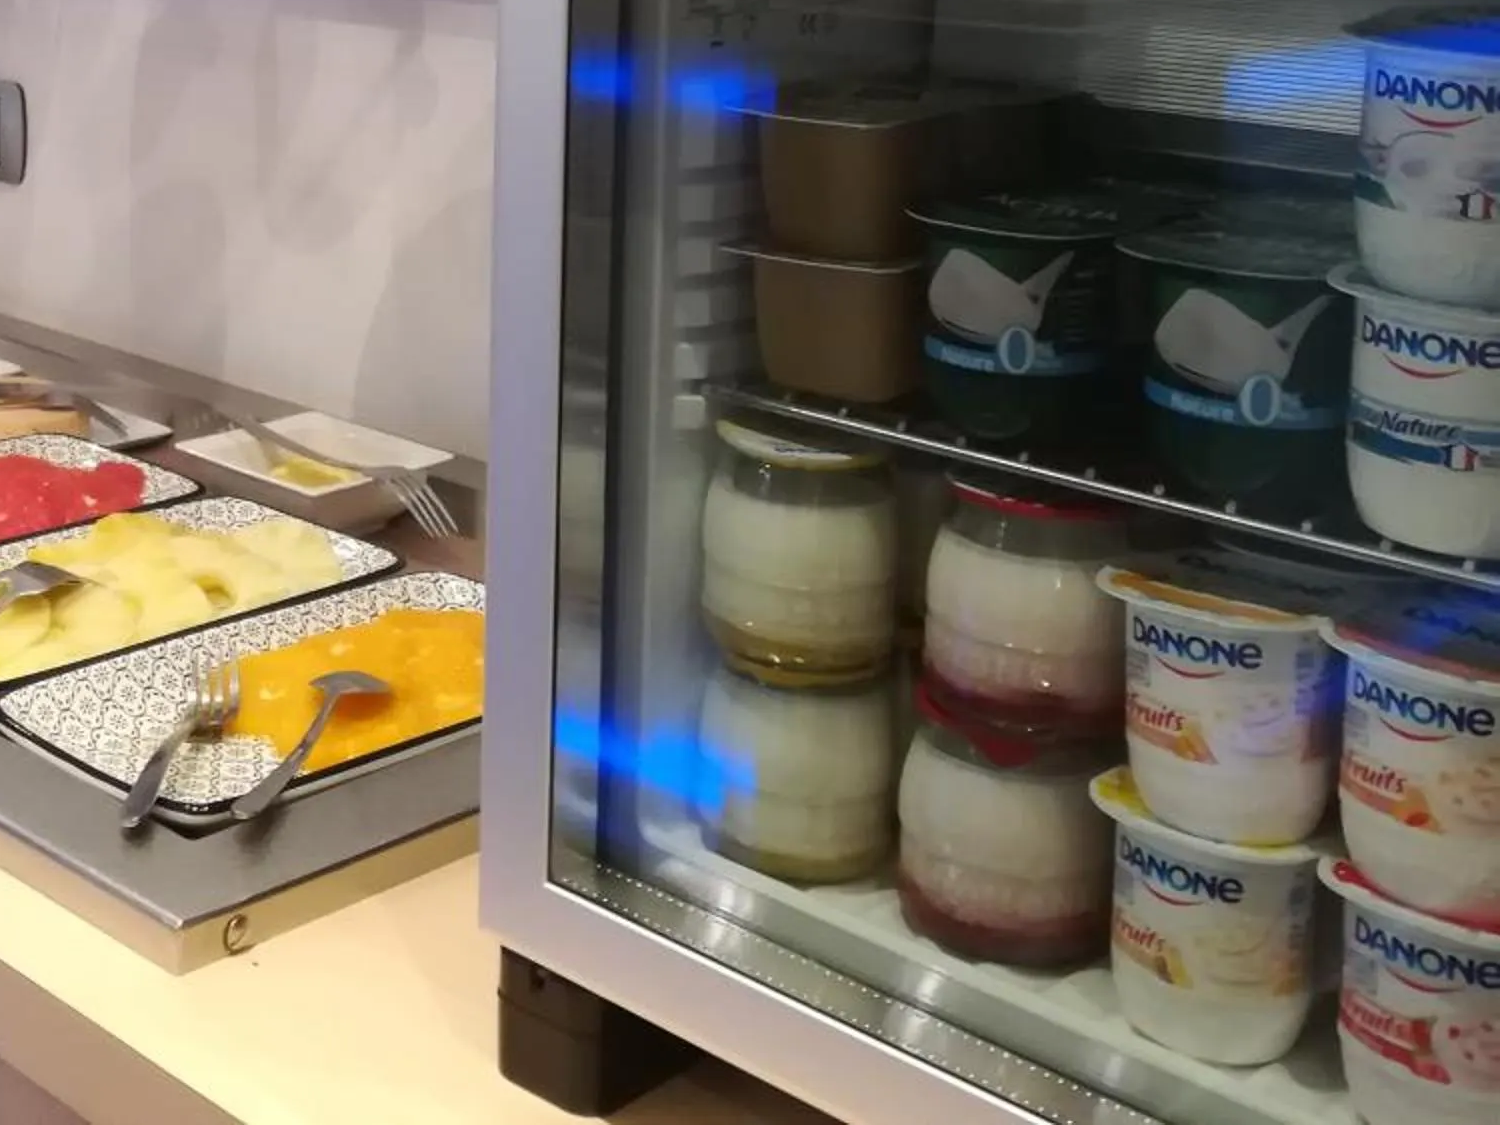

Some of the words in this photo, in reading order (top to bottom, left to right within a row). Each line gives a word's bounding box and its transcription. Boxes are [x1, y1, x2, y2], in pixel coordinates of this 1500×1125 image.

[1375, 68, 1500, 114] DANON
[1132, 615, 1263, 670] DANONE
[1354, 670, 1496, 737] DANONE
[1119, 834, 1245, 905] DANONE
[1354, 916, 1500, 989] DANONE
